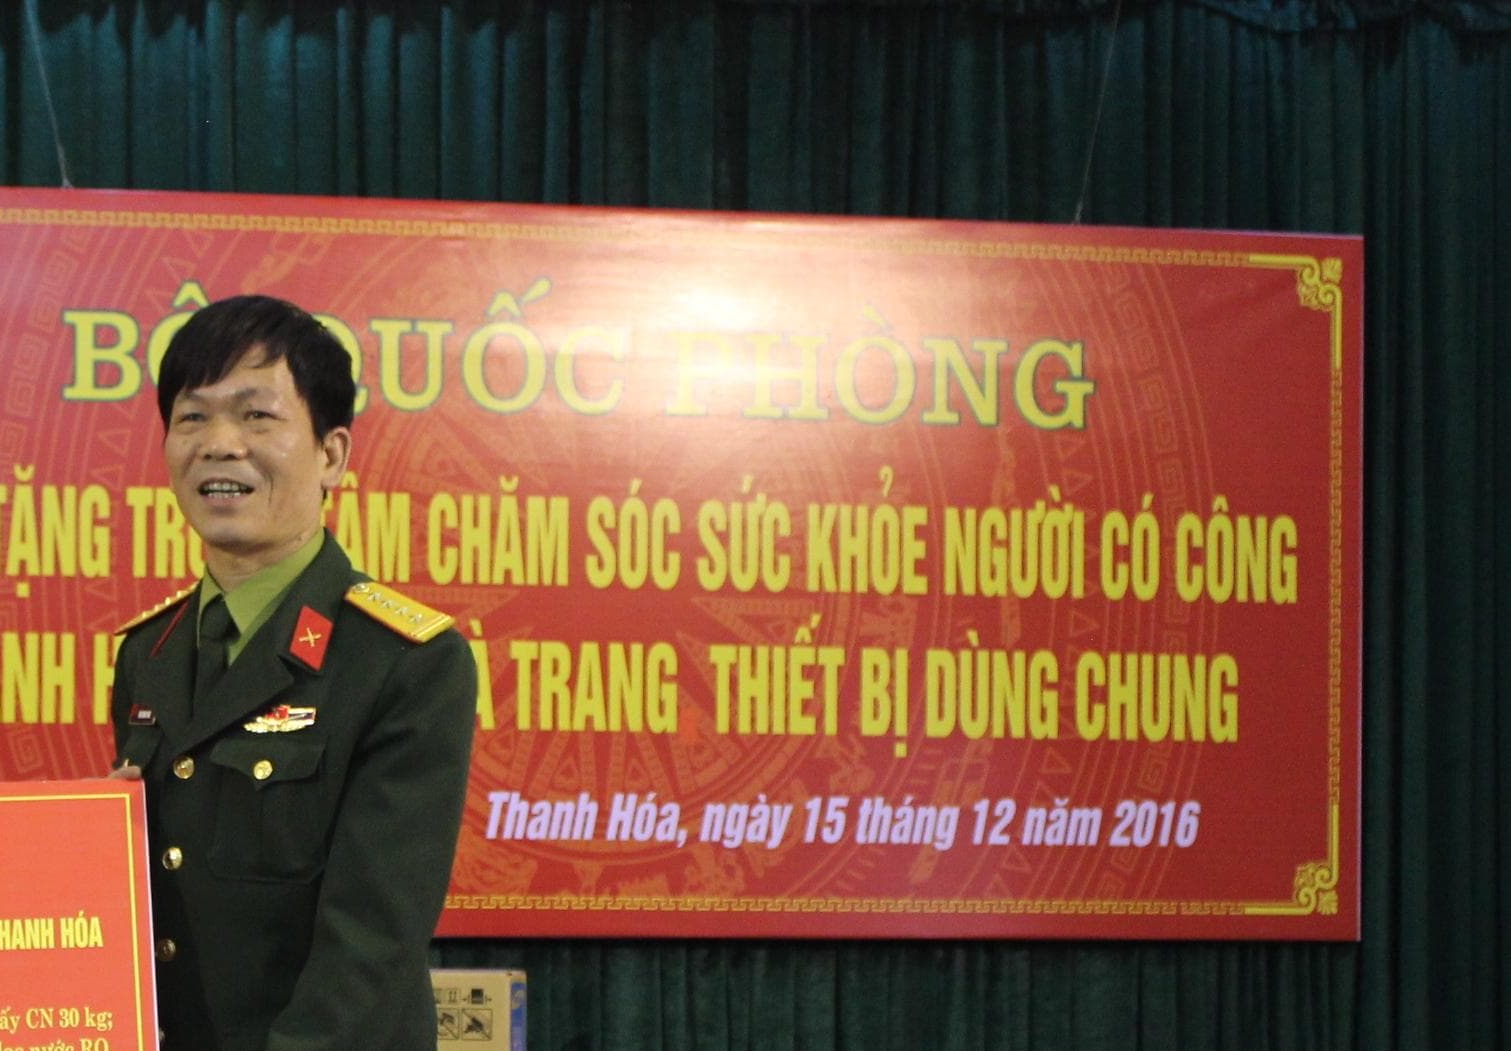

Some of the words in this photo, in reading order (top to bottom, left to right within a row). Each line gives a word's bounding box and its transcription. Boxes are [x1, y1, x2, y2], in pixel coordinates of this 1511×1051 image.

[664, 306, 1095, 430] PHÒNG
[320, 471, 410, 583] ÂM
[427, 475, 570, 587] CHĂM
[585, 478, 681, 590] SÓC
[696, 474, 791, 593] SỨC
[806, 464, 928, 596] KHỎE
[944, 484, 1085, 600] NGƯỜI
[1100, 492, 1160, 601] CÓ
[1175, 495, 1298, 604] CÔNG
[510, 640, 679, 733] TRANG
[709, 613, 846, 735] THIẾT
[861, 646, 908, 758] BỊ
[926, 629, 1059, 740] DÙNG
[1075, 651, 1239, 743] CHUNG
[486, 790, 599, 841] Thanh
[606, 792, 687, 848] Hóa,
[699, 794, 793, 849] ngày
[803, 796, 848, 844] 15
[855, 795, 959, 851] tháng
[972, 798, 1017, 847] 12
[1022, 796, 1103, 848] năm
[1109, 800, 1201, 848] 2016
[61, 910, 103, 949] HÓA
[26, 1007, 54, 1030] CN
[59, 1008, 79, 1029] 30
[84, 1006, 112, 1032] kg;
